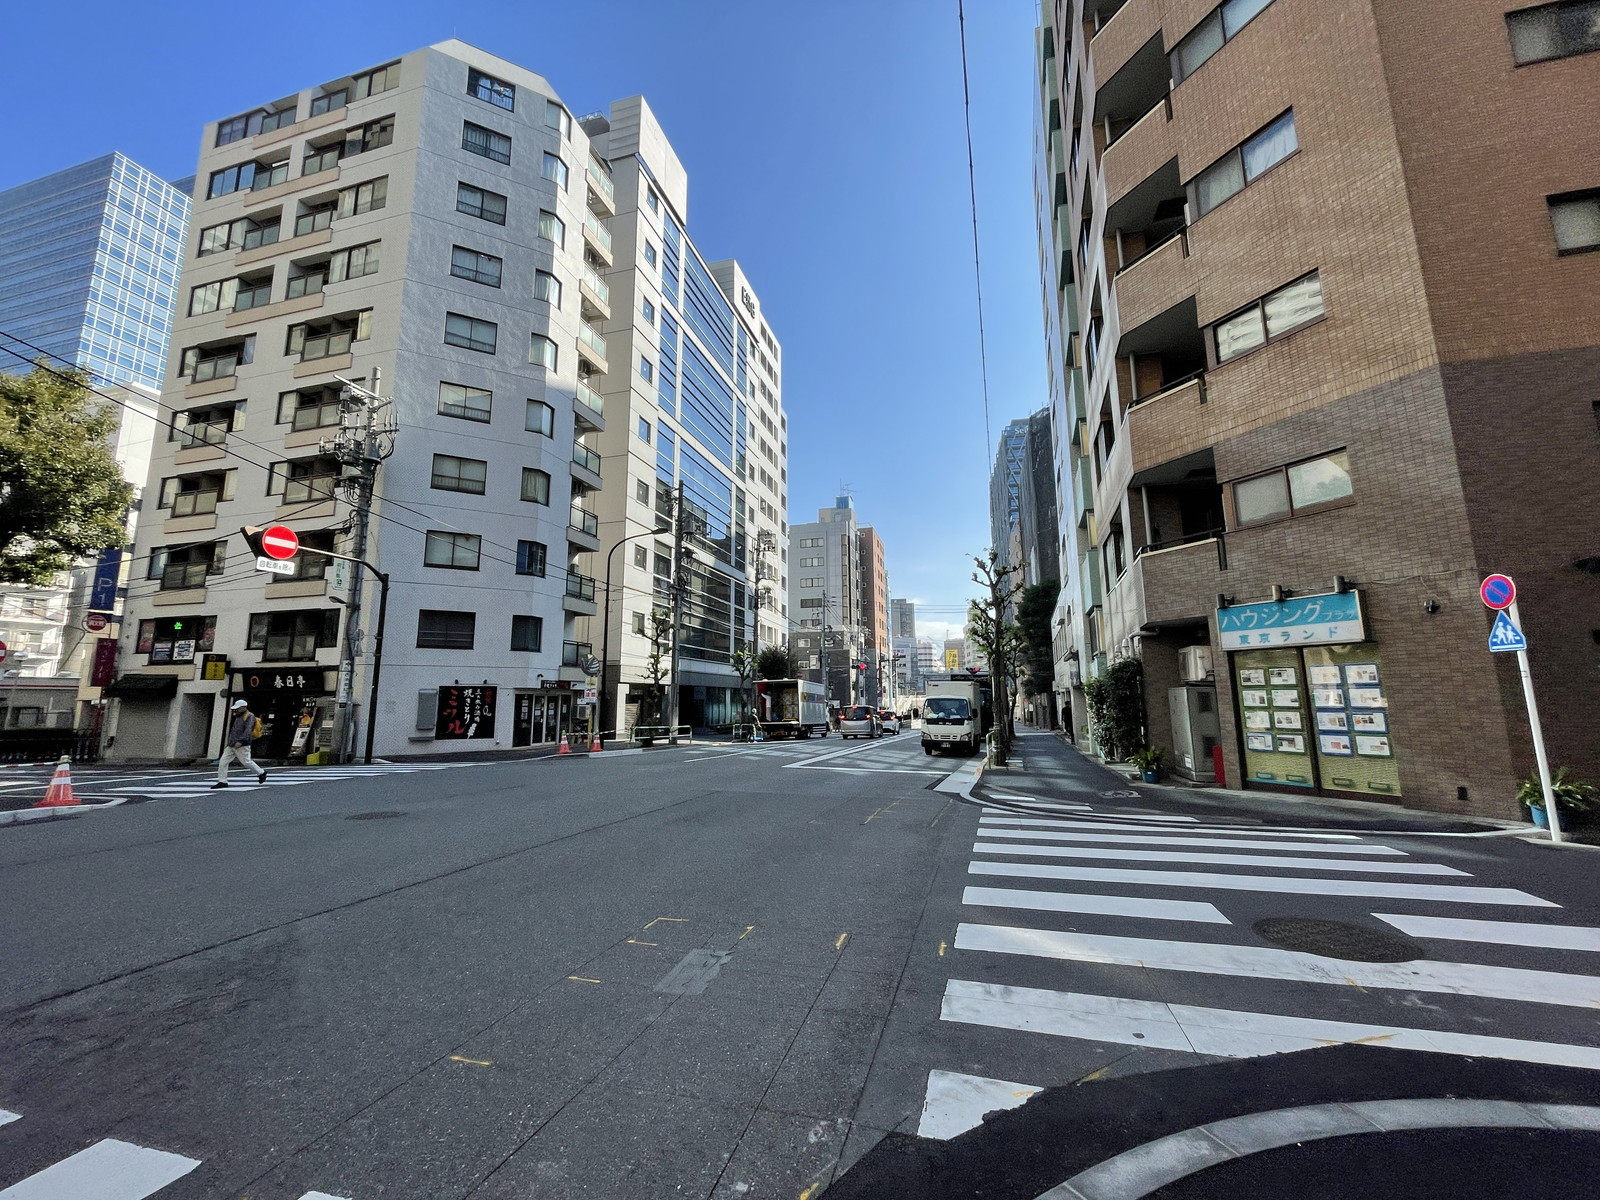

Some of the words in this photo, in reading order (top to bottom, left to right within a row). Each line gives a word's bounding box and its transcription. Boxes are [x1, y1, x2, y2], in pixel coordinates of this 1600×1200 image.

[258, 560, 293, 573] 自転車を除く
[1221, 600, 1324, 629] ハウジング
[1238, 626, 1339, 646] 東京ランド
[273, 674, 306, 689] 春日亭
[463, 688, 475, 725] 焼きとり
